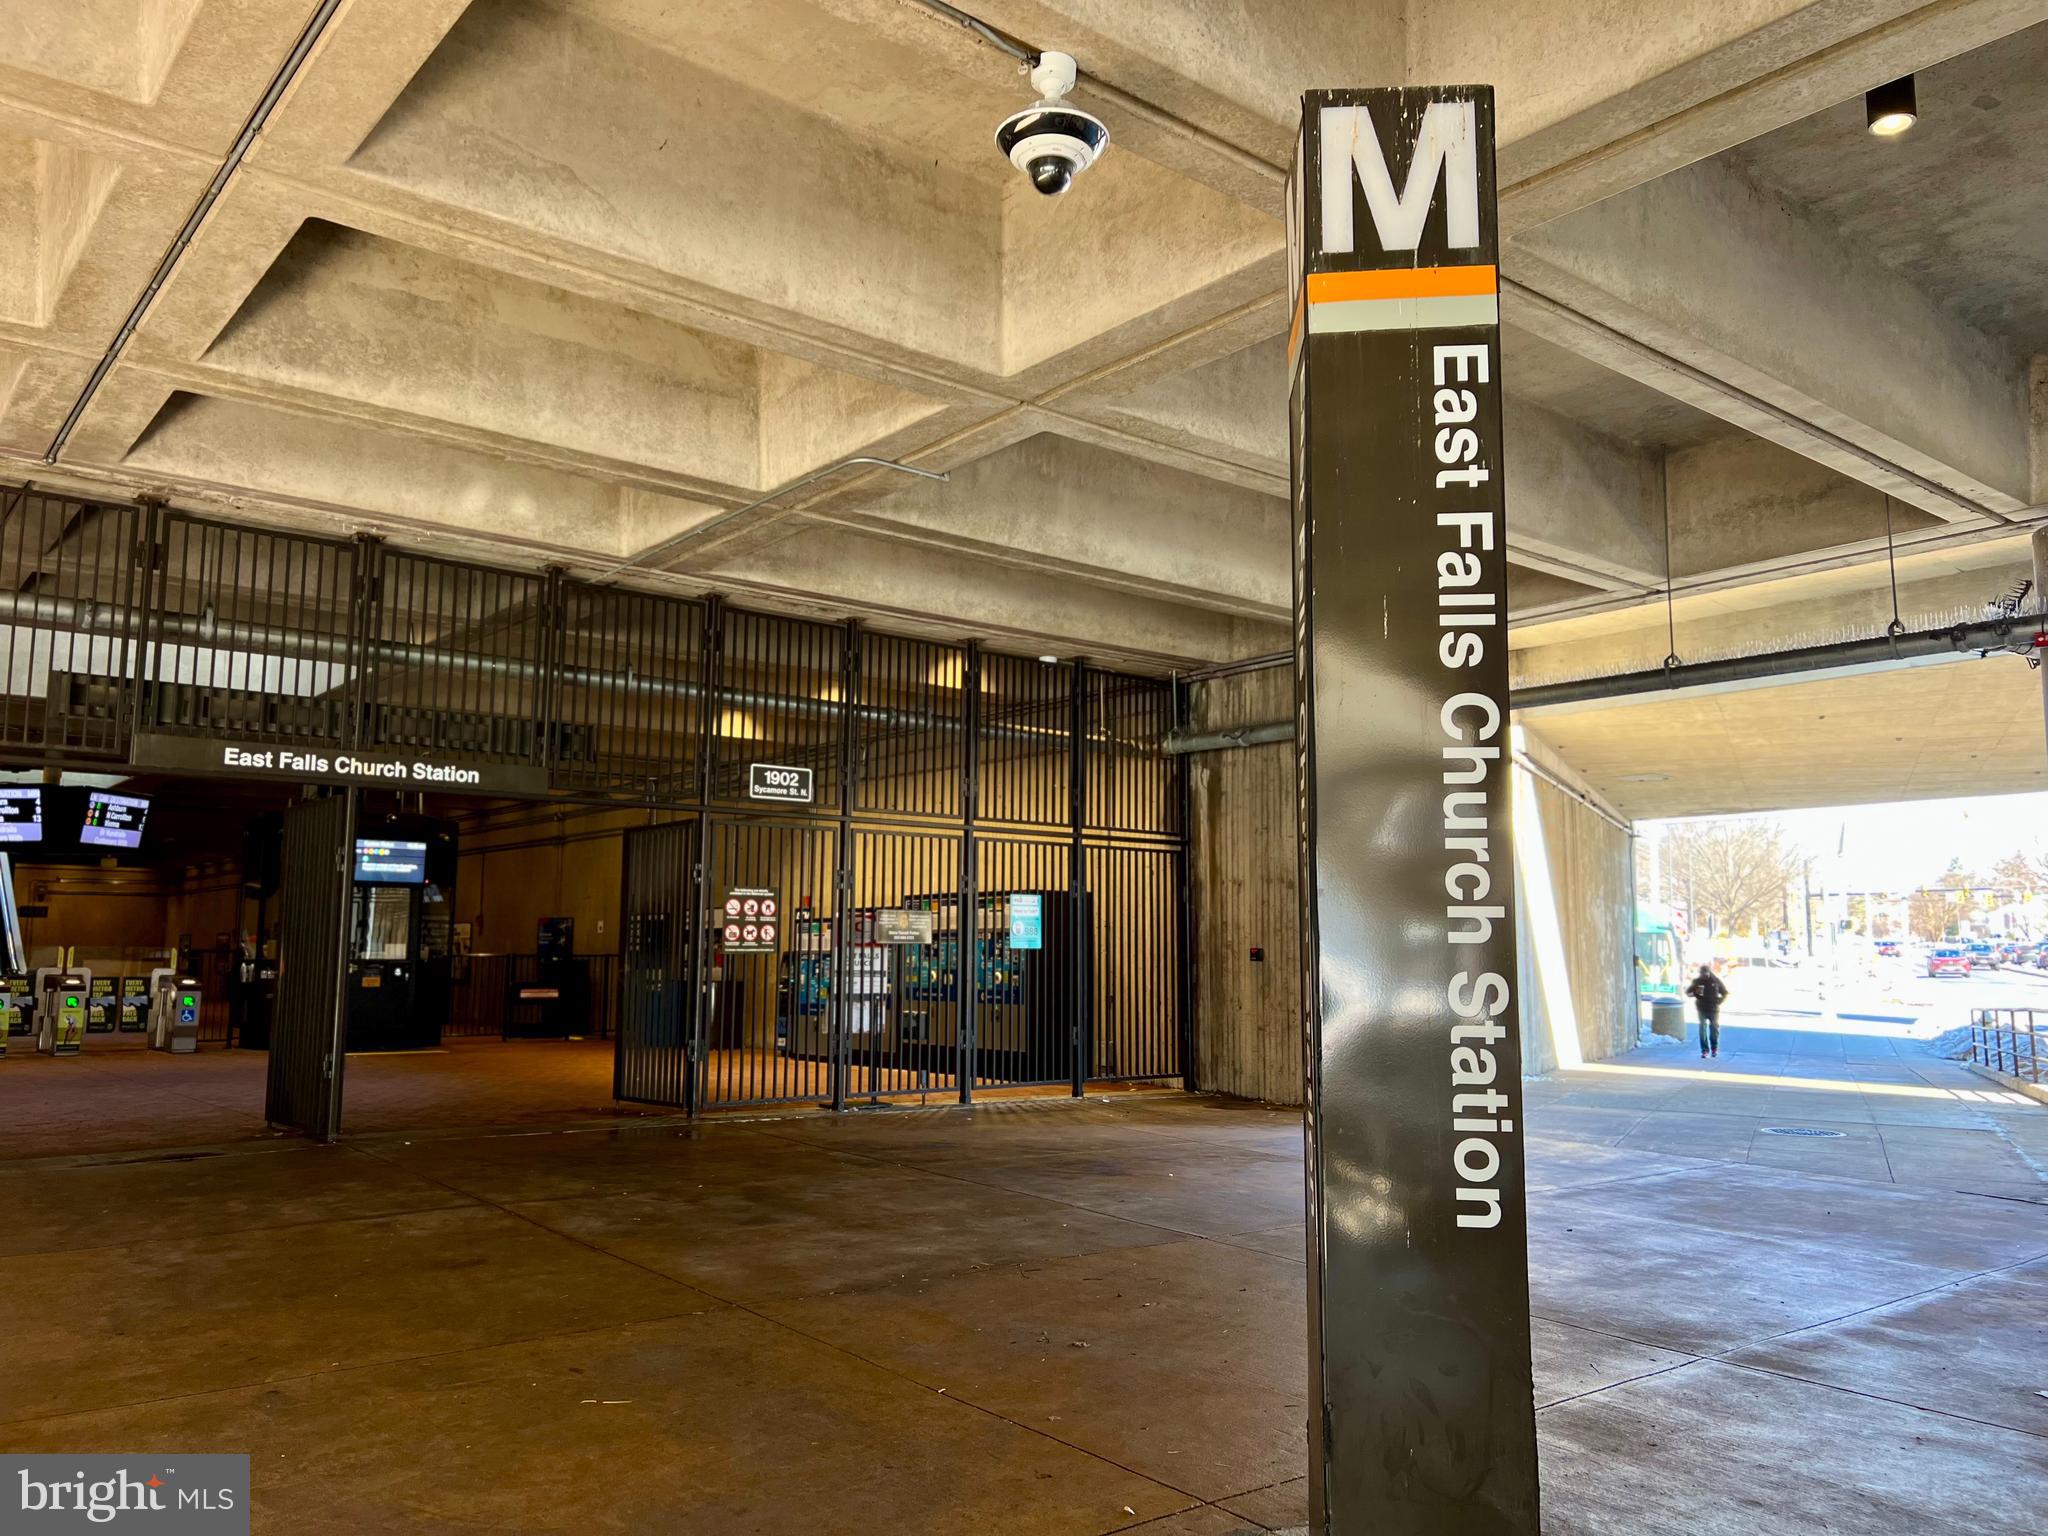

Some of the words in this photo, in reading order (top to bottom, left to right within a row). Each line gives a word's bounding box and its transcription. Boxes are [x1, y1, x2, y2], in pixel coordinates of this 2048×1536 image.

[1320, 101, 1480, 254] M
[1433, 344, 1489, 489] East
[1437, 512, 1496, 669] Falls
[224, 747, 273, 767] East
[279, 752, 328, 772] Falls
[334, 756, 406, 778] Church
[412, 762, 479, 784] Station
[754, 784, 788, 795] Sycamore
[764, 770, 799, 787] 1902
[1440, 692, 1505, 944] Church
[1448, 971, 1513, 1228] Station
